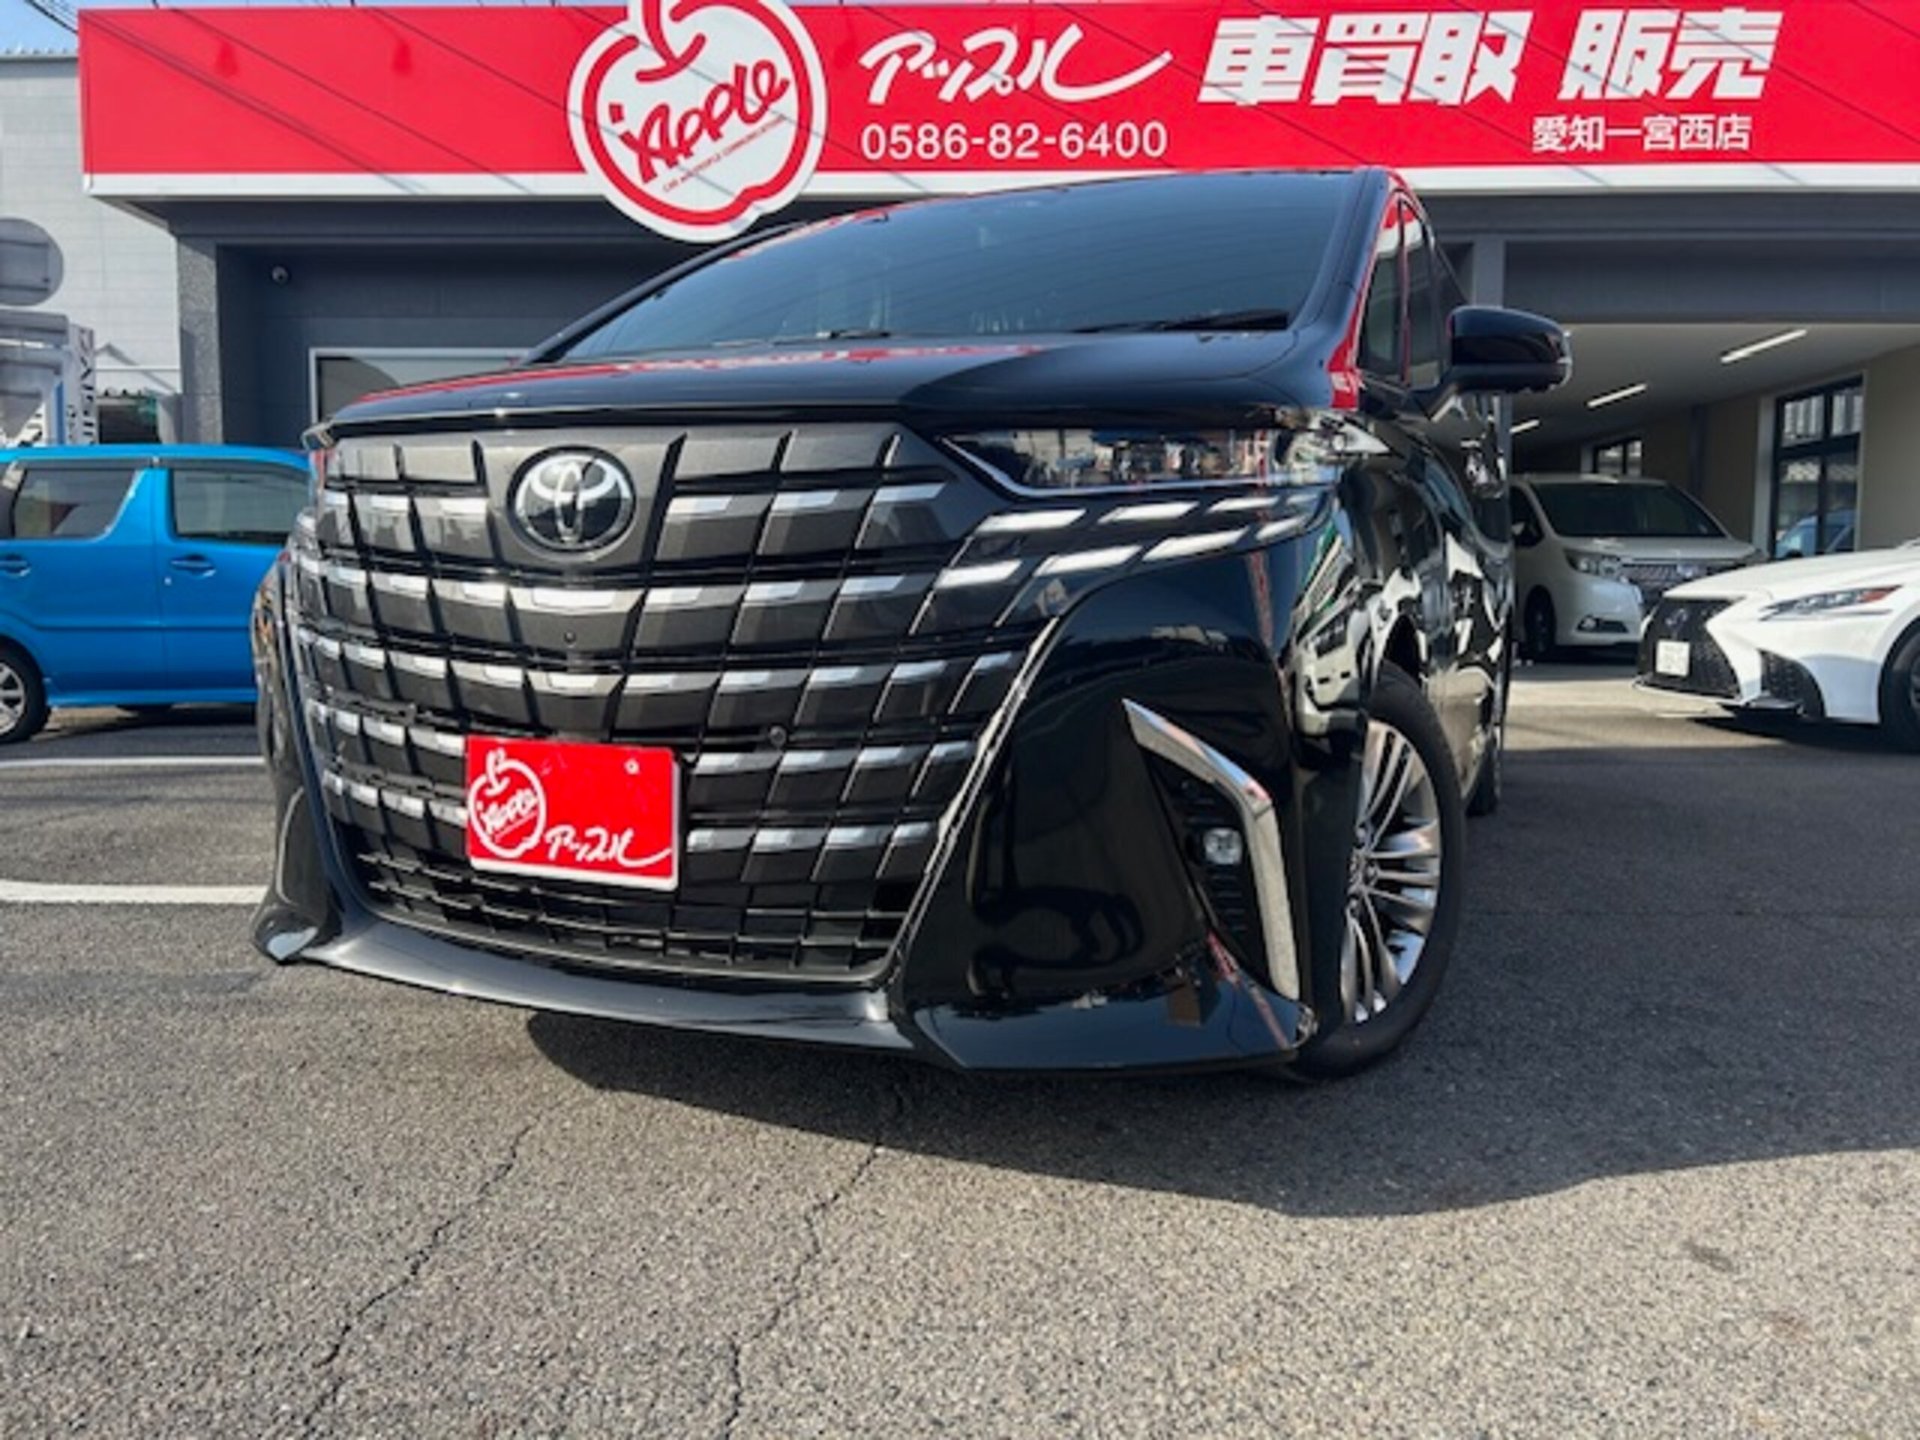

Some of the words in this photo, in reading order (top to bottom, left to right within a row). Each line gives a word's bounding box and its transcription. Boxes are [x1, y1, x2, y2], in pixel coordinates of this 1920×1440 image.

[859, 23, 1173, 105] アップル
[1197, 11, 1534, 106] 車買取
[1556, 7, 1784, 101] 販売
[861, 121, 1168, 160] 0586-82-6400
[1532, 113, 1752, 153] 愛知一宮西店
